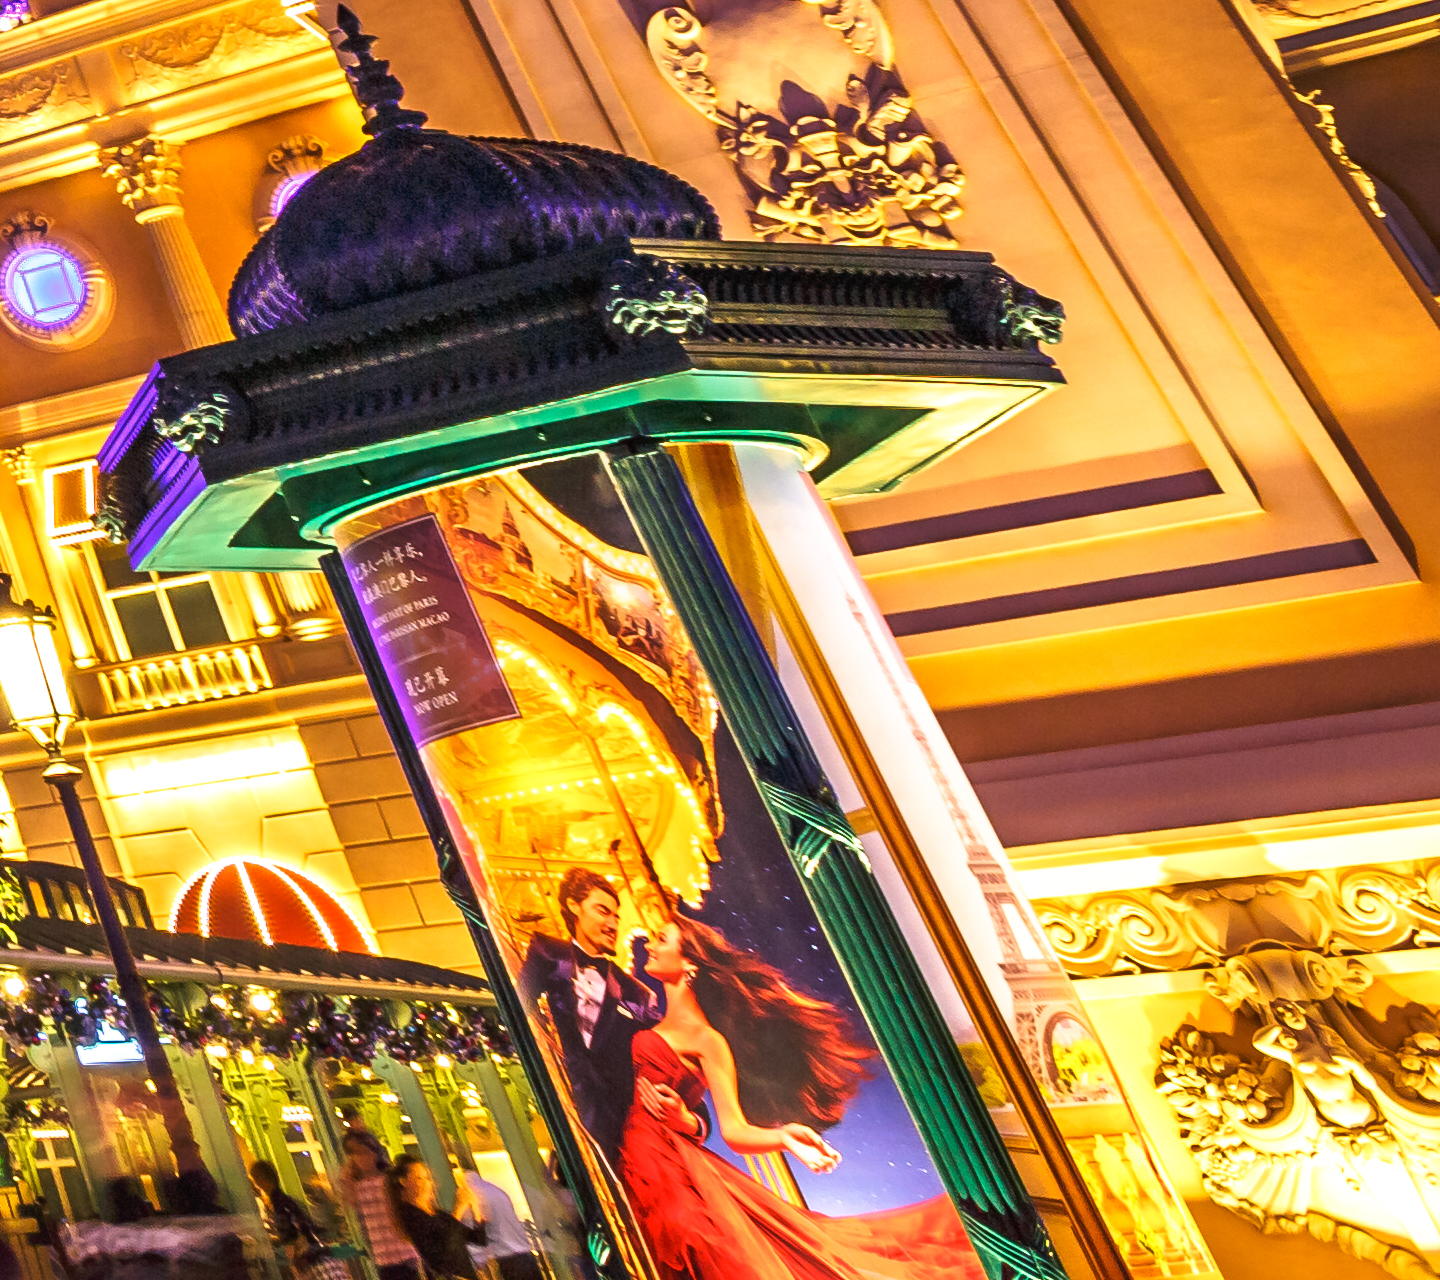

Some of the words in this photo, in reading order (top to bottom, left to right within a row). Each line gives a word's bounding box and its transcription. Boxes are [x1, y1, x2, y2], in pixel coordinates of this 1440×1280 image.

[413, 595, 439, 611] PARIS
[417, 611, 450, 629] MACAO
[430, 691, 460, 710] OPEN
